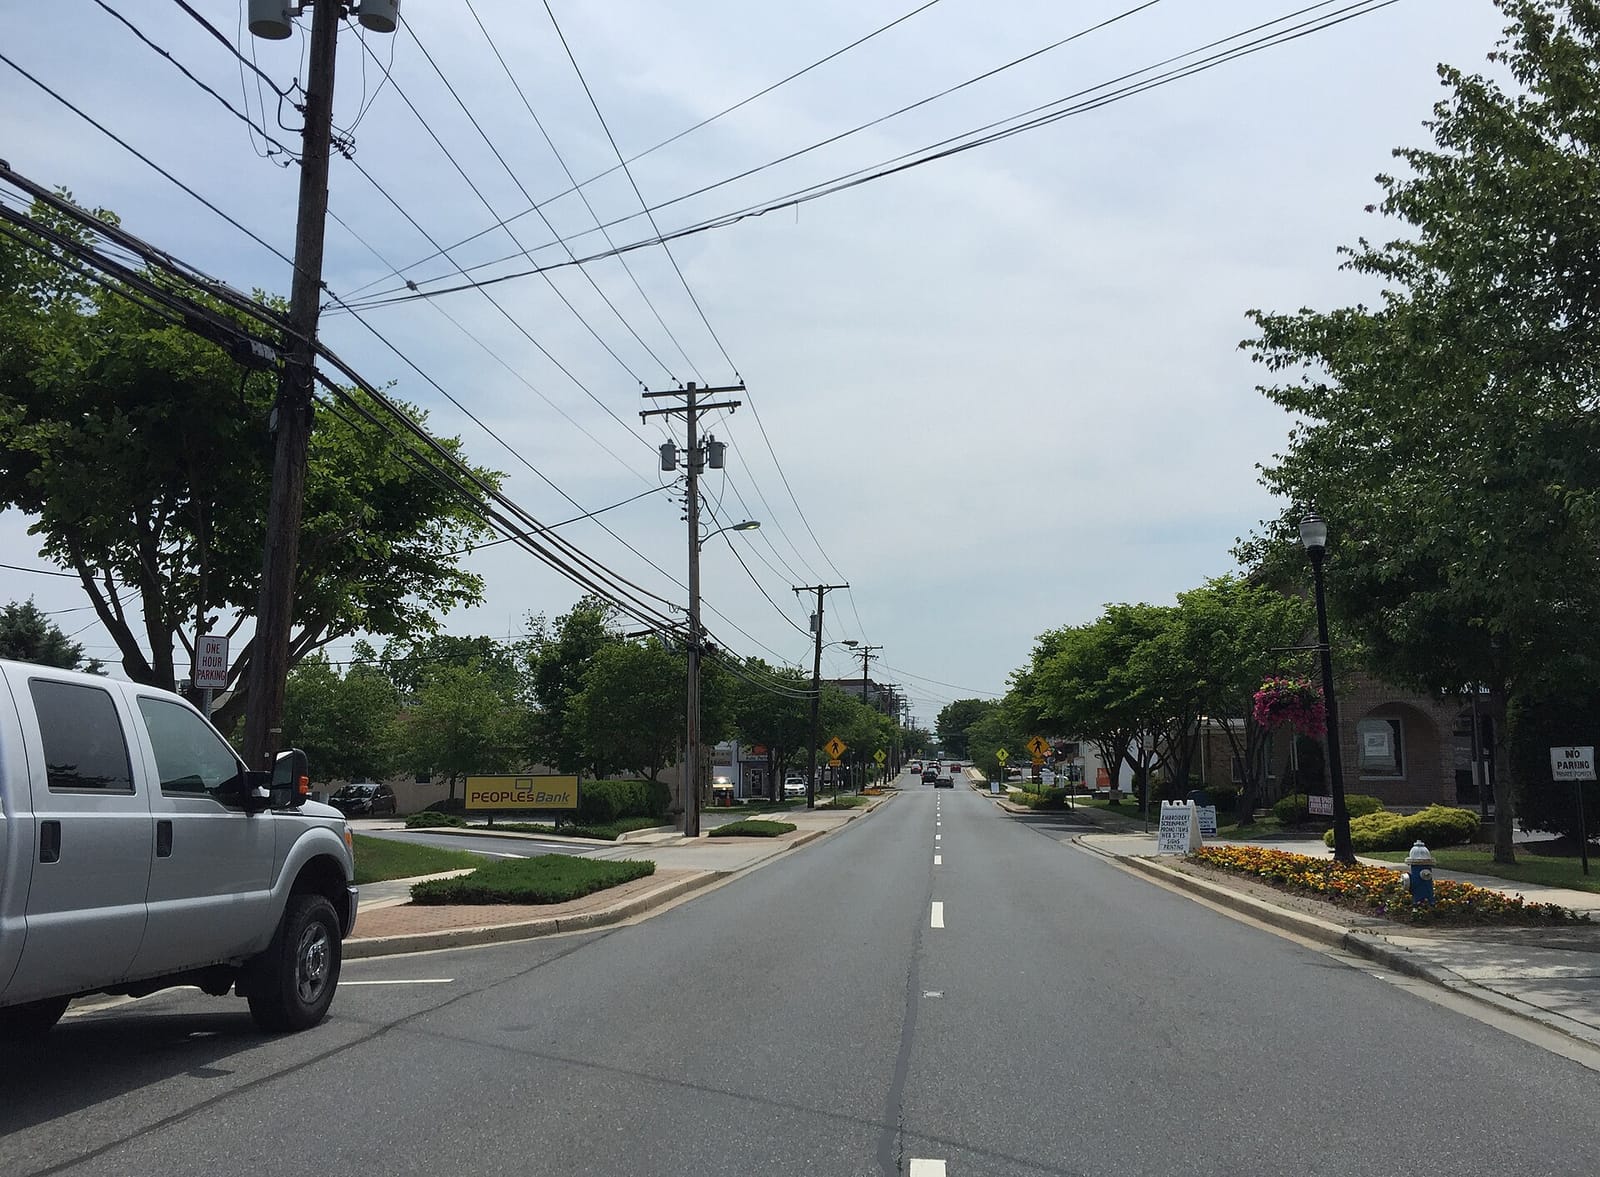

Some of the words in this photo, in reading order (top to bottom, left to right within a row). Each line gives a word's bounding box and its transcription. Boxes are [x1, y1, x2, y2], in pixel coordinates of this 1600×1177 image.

[206, 643, 221, 654] ONE
[202, 656, 222, 667] HOUR
[197, 670, 226, 680] PARKING
[1565, 750, 1580, 758] NO
[1557, 761, 1590, 770] PARKING
